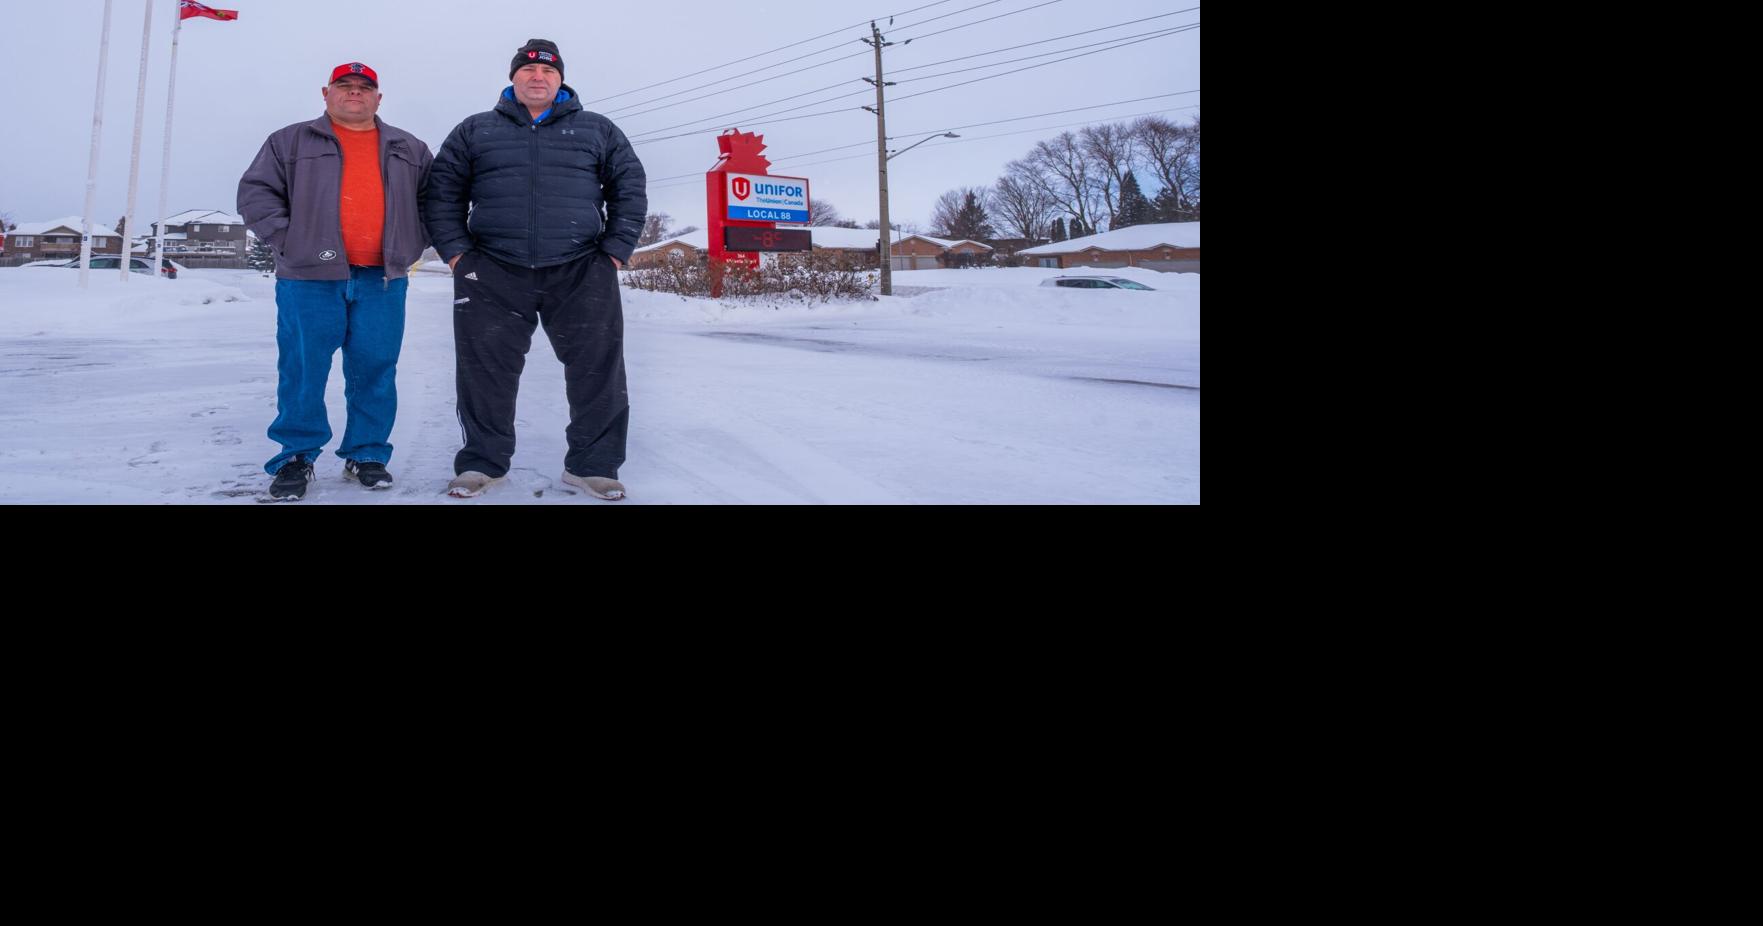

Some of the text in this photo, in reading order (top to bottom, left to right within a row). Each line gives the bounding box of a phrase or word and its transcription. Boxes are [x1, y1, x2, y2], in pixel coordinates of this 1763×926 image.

[754, 183, 803, 198] UNIFOR
[747, 209, 792, 220] LOCAL 88
